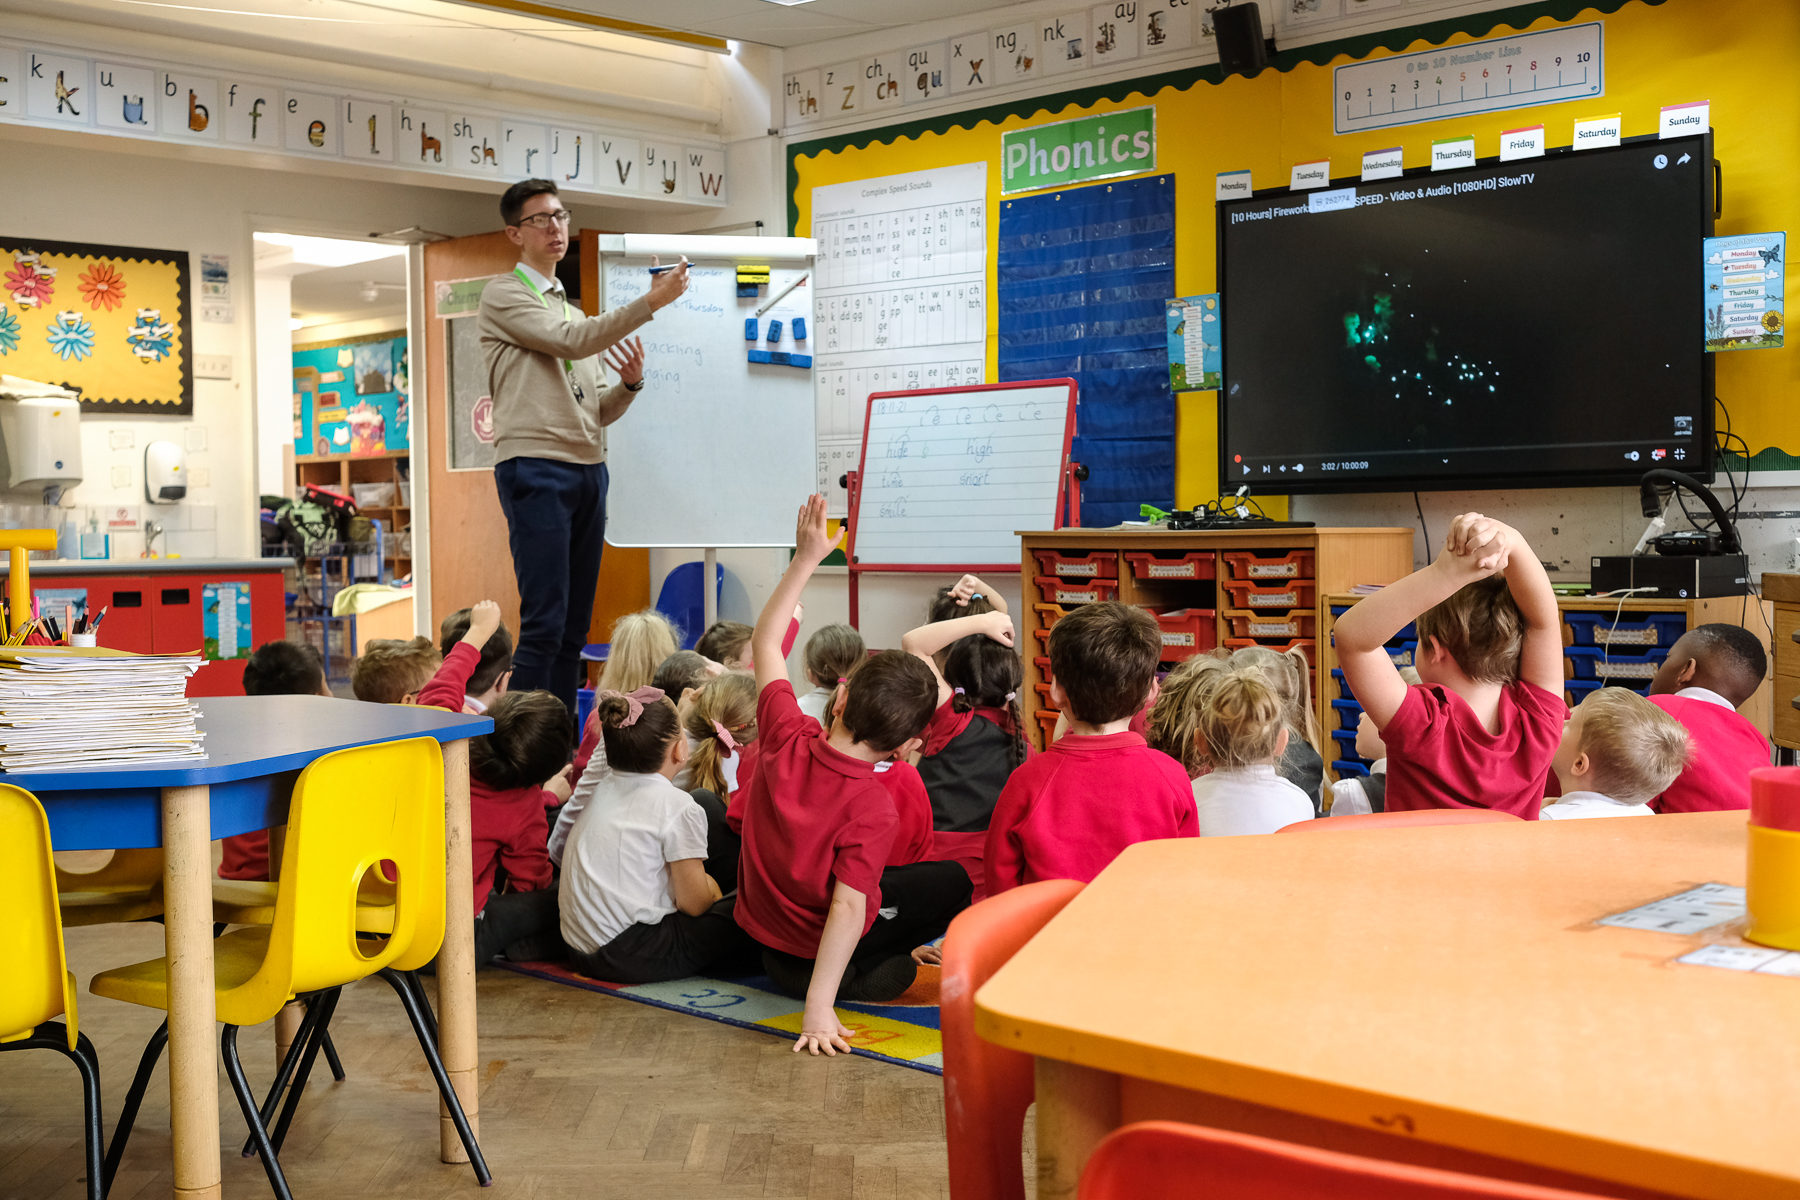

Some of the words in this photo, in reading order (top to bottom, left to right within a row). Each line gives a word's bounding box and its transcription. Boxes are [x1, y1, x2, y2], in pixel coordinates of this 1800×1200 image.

[787, 76, 801, 96] th
[826, 72, 834, 85] z
[866, 59, 883, 79] ch
[909, 51, 928, 72] qu
[954, 44, 962, 57] x
[995, 32, 1017, 52] ng
[1044, 19, 1065, 41] nk
[1115, 1, 1136, 23] ay
[1406, 62, 1414, 73] 0
[1417, 62, 1429, 72] to
[1433, 57, 1447, 69] 10
[1450, 50, 1495, 66] Number
[1499, 45, 1522, 58] Line
[1345, 92, 1351, 101] 0
[1367, 88, 1372, 97] 1
[1390, 84, 1396, 93] 2
[1414, 80, 1420, 89] 3
[1435, 76, 1443, 85] 4
[1460, 72, 1466, 82] 5
[1482, 68, 1489, 78] 6
[1506, 65, 1513, 74] 7
[1530, 61, 1537, 71] 8
[1555, 57, 1562, 67] 9
[1577, 52, 1591, 63] 10
[31, 54, 43, 78] k
[100, 71, 114, 87] u
[165, 73, 177, 97] b
[228, 84, 238, 107] f
[287, 99, 297, 113] e
[347, 102, 353, 123] l
[401, 109, 412, 131] h
[453, 117, 473, 138] sh
[506, 128, 513, 142] r
[552, 132, 559, 155] j
[602, 141, 611, 154] v
[647, 147, 654, 165] y
[689, 154, 703, 167] w
[1007, 126, 1151, 180] Phonics
[1221, 181, 1247, 191] Monday
[1297, 170, 1324, 180] Tuesday
[1363, 159, 1402, 171] Wednesday
[1435, 148, 1472, 160] Thursday
[1510, 139, 1535, 150] Friday
[1578, 127, 1617, 139] Saturday
[1669, 114, 1700, 127] Sunday
[861, 187, 887, 198] Complex
[889, 184, 907, 195] Speed
[909, 180, 932, 191] Sounds
[1231, 212, 1245, 224] [10
[1245, 208, 1272, 221] Hours]
[1355, 195, 1383, 207] SPEED
[1390, 190, 1417, 202] Video
[1417, 189, 1425, 199] &
[1425, 185, 1452, 197] Audio
[1454, 177, 1497, 195] [1080HD]
[1498, 173, 1535, 188] SlowTV
[1731, 250, 1757, 258] Monday
[688, 269, 724, 277] ovember
[1731, 263, 1756, 271] Tuesday
[609, 278, 641, 295] Today
[1729, 289, 1759, 297] Thursday
[681, 299, 724, 317] Thursday
[886, 441, 908, 459] hide
[966, 438, 994, 463] high
[1341, 461, 1369, 470] 10:00:09
